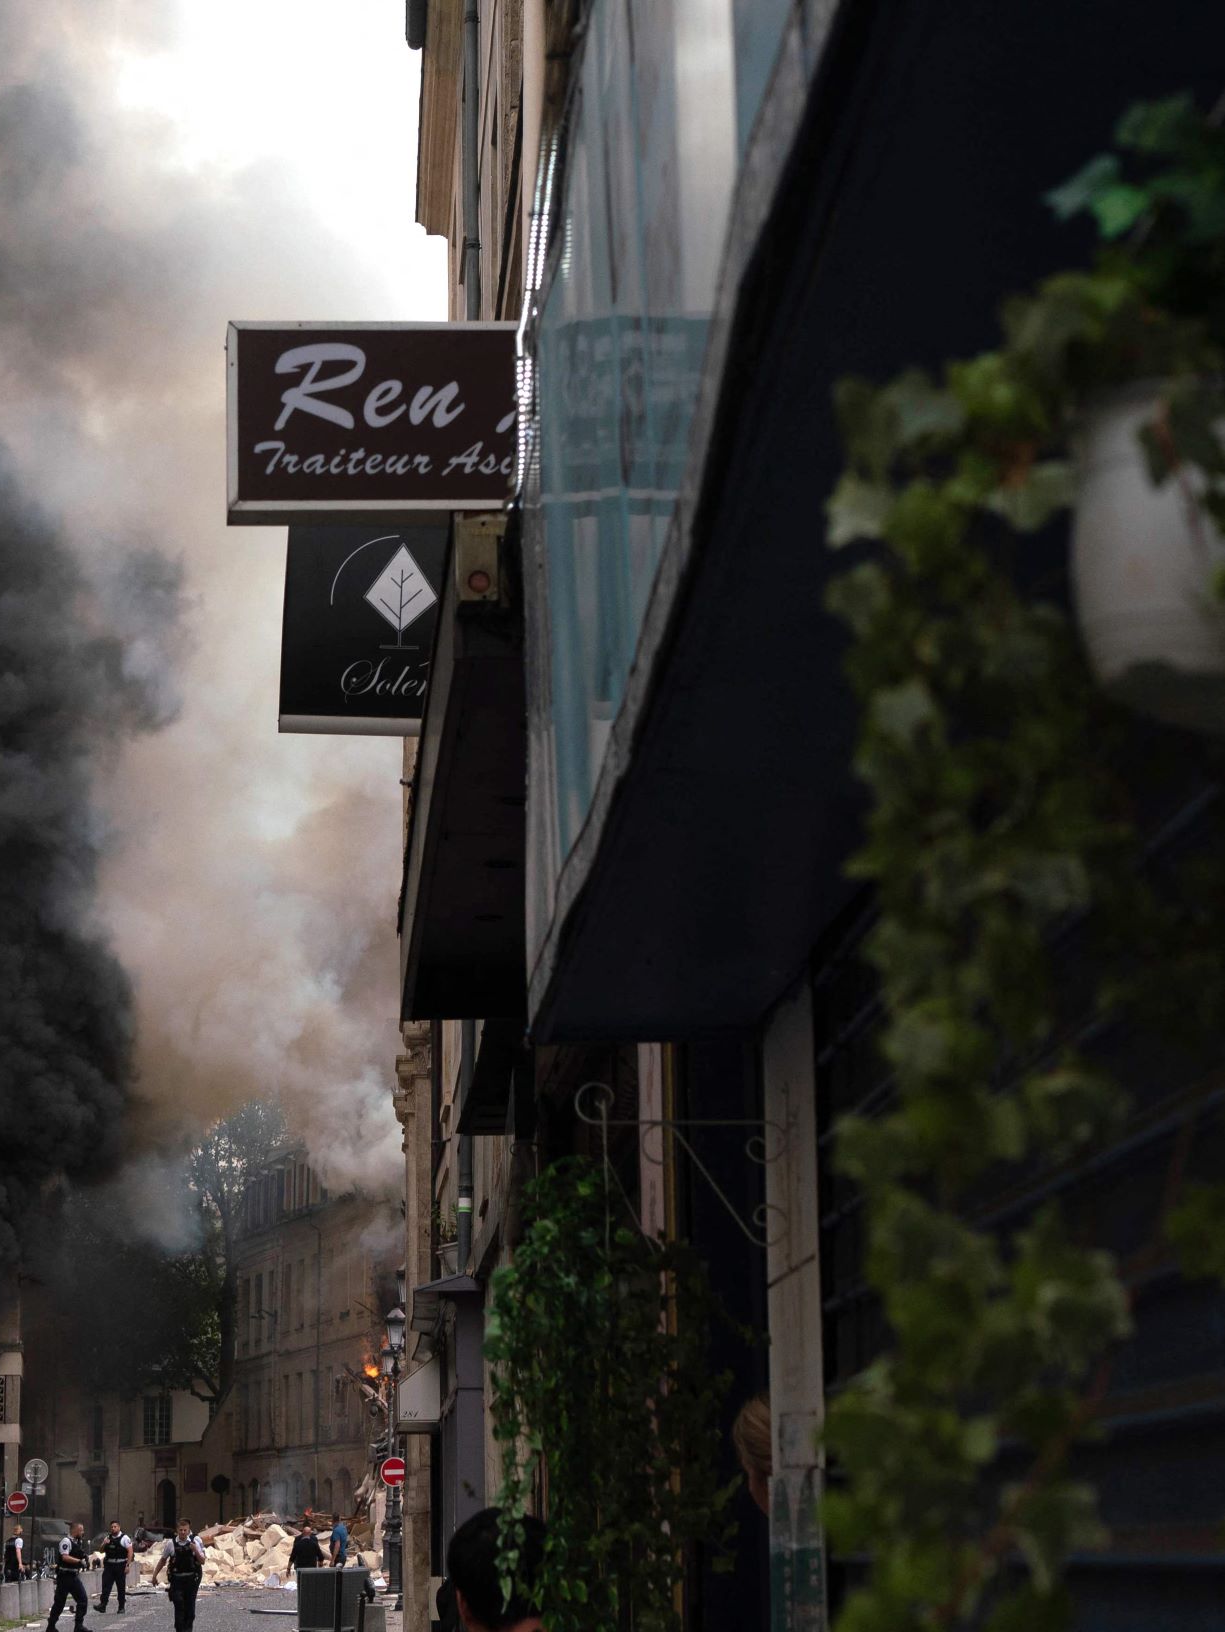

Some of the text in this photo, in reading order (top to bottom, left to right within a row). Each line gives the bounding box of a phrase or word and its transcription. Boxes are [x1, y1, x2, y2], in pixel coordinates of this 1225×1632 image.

[274, 343, 465, 431] Ren
[254, 440, 513, 476] Traiteur Asi
